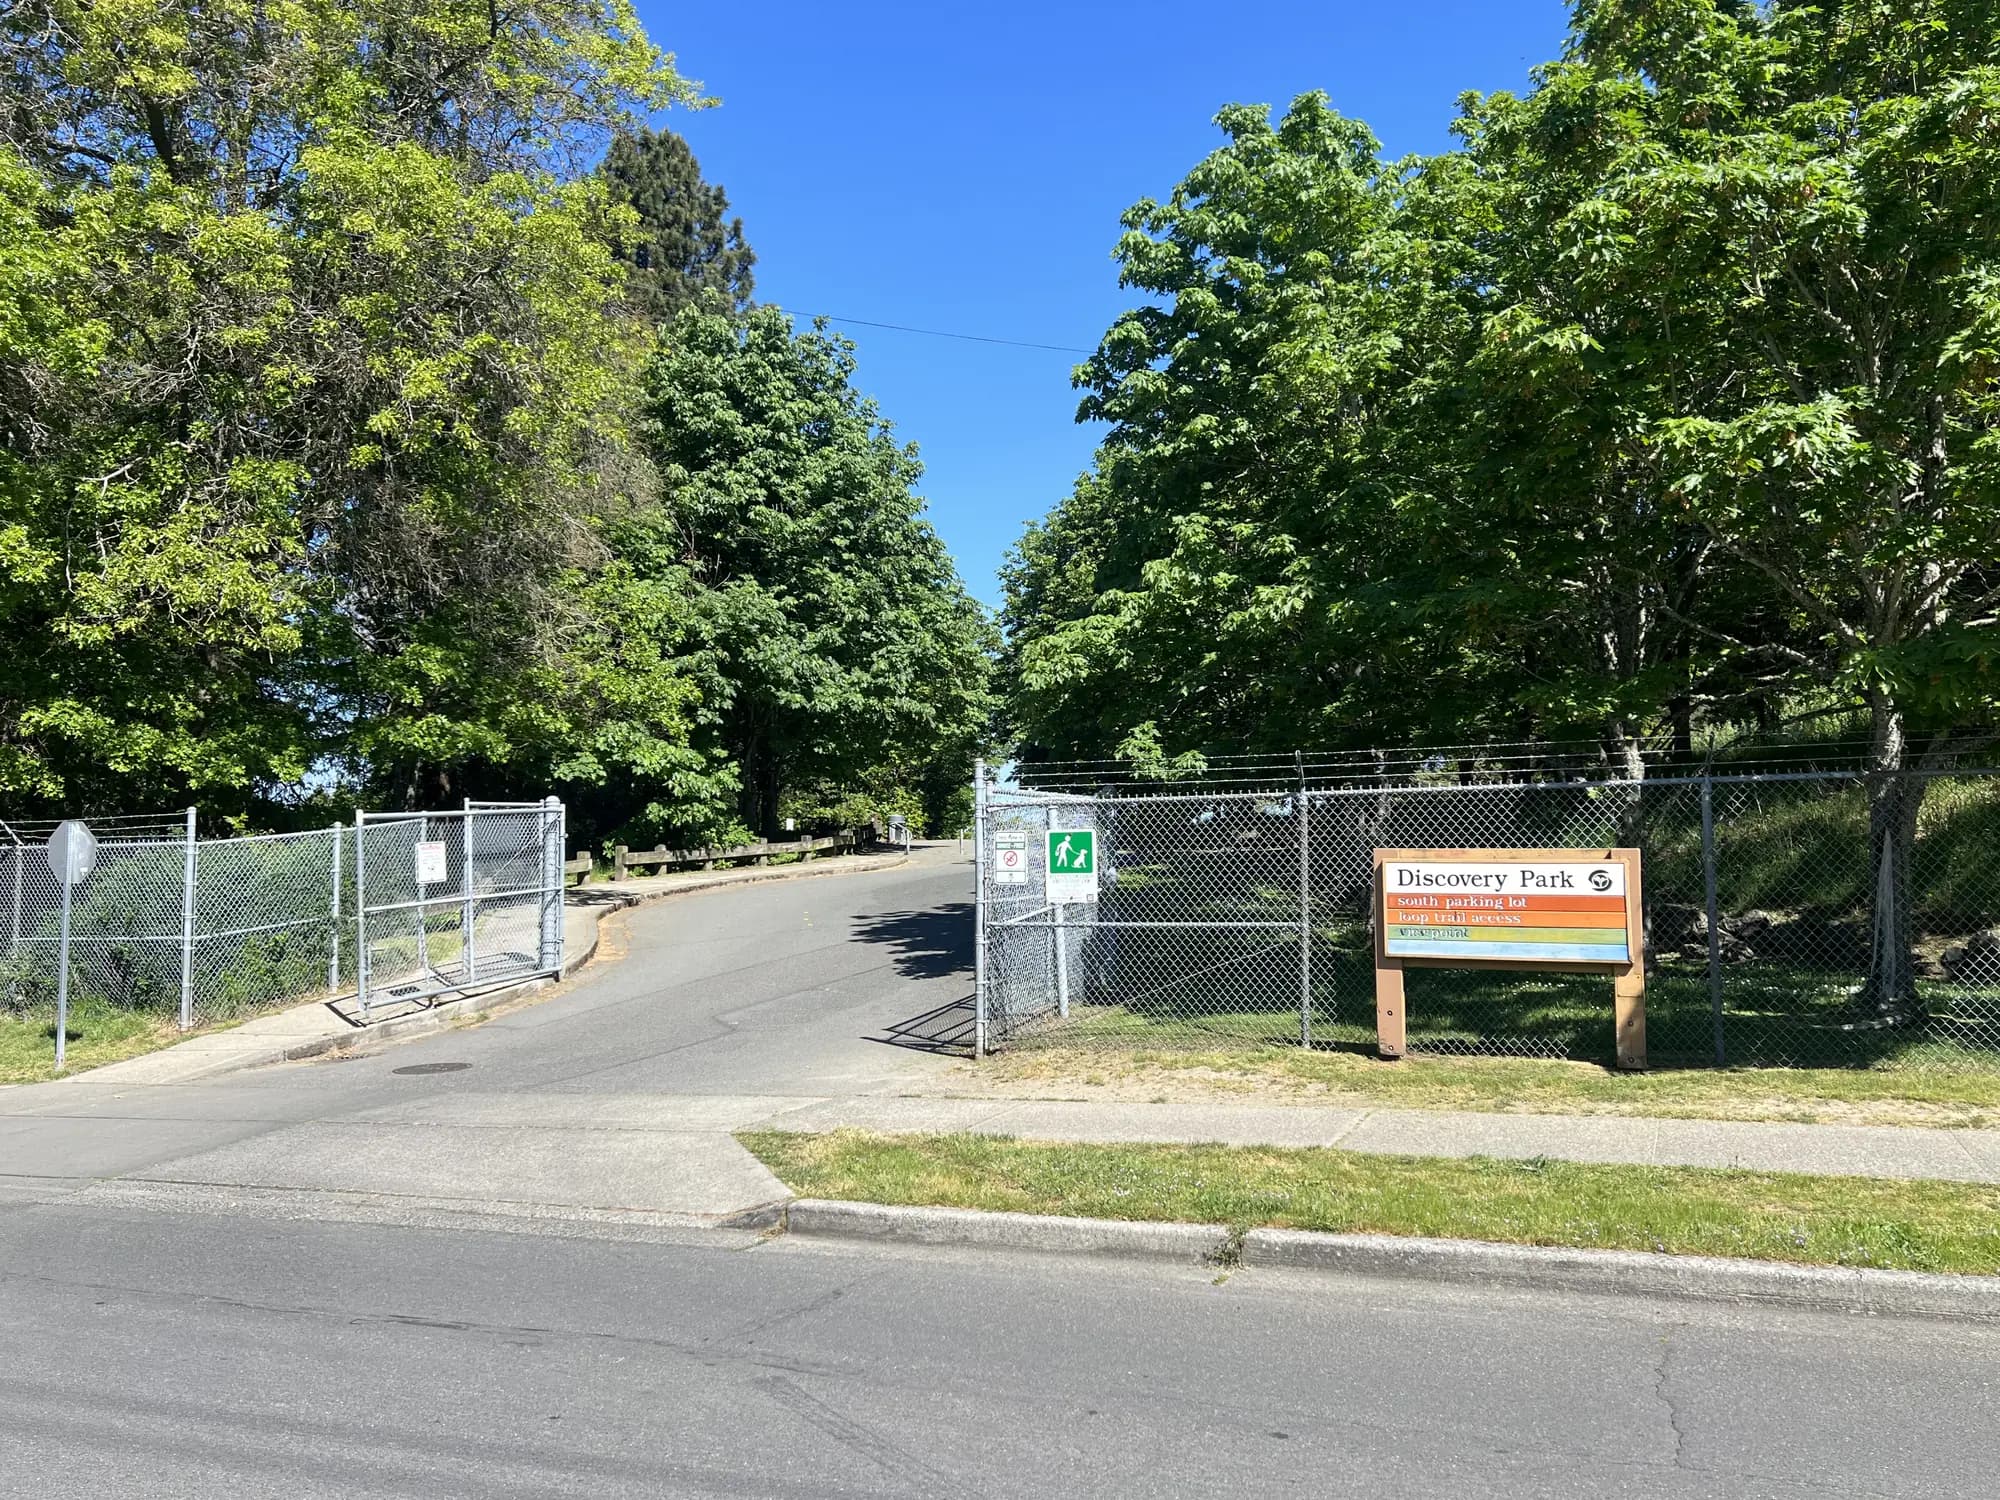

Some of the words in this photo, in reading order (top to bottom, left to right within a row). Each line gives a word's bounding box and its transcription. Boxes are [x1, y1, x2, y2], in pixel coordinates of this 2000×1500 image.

[1398, 869, 1507, 892] Discovery
[1520, 870, 1575, 888] Park
[1398, 896, 1438, 907] south
[1446, 896, 1504, 909] parking
[1508, 897, 1527, 908] lot
[1399, 912, 1429, 925] loop
[1434, 911, 1467, 923] trail
[1471, 914, 1521, 924] access
